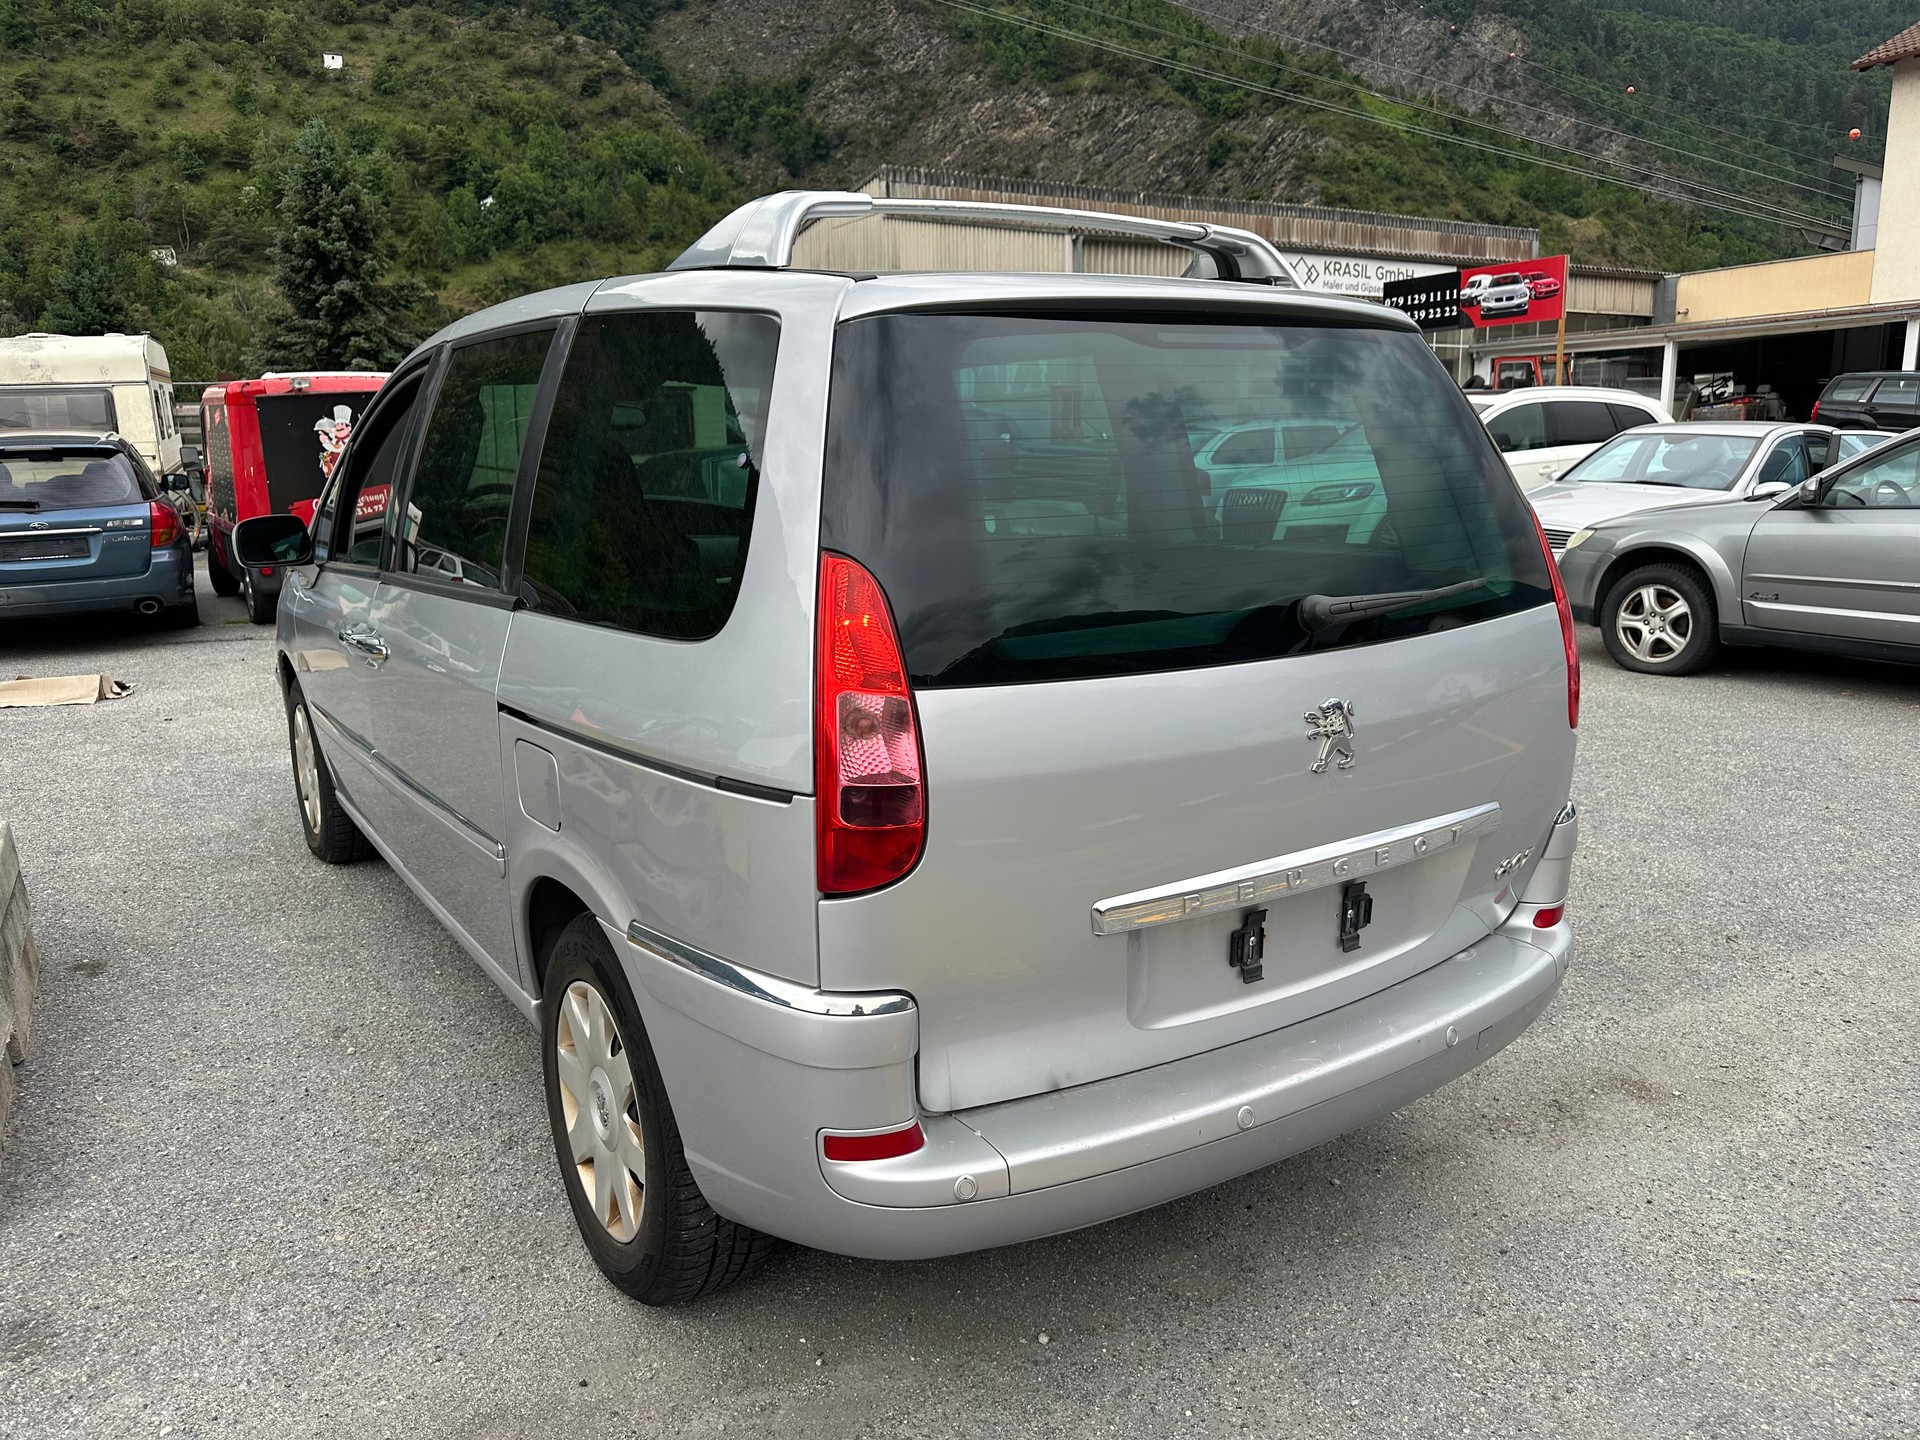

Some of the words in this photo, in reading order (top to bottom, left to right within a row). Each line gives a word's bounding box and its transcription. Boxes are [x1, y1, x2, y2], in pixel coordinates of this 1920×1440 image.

[1323, 260, 1371, 279] KRASIL
[1375, 265, 1415, 282] GmbH
[1322, 280, 1343, 291] Maler
[1344, 281, 1359, 292] und
[1384, 296, 1404, 307] 079
[1407, 292, 1427, 305] 129
[1429, 290, 1441, 302] 11
[1445, 288, 1457, 300] 11
[1428, 307, 1442, 319] 22
[1443, 305, 1458, 317] 22
[1183, 824, 1464, 914] PEUGEOT
